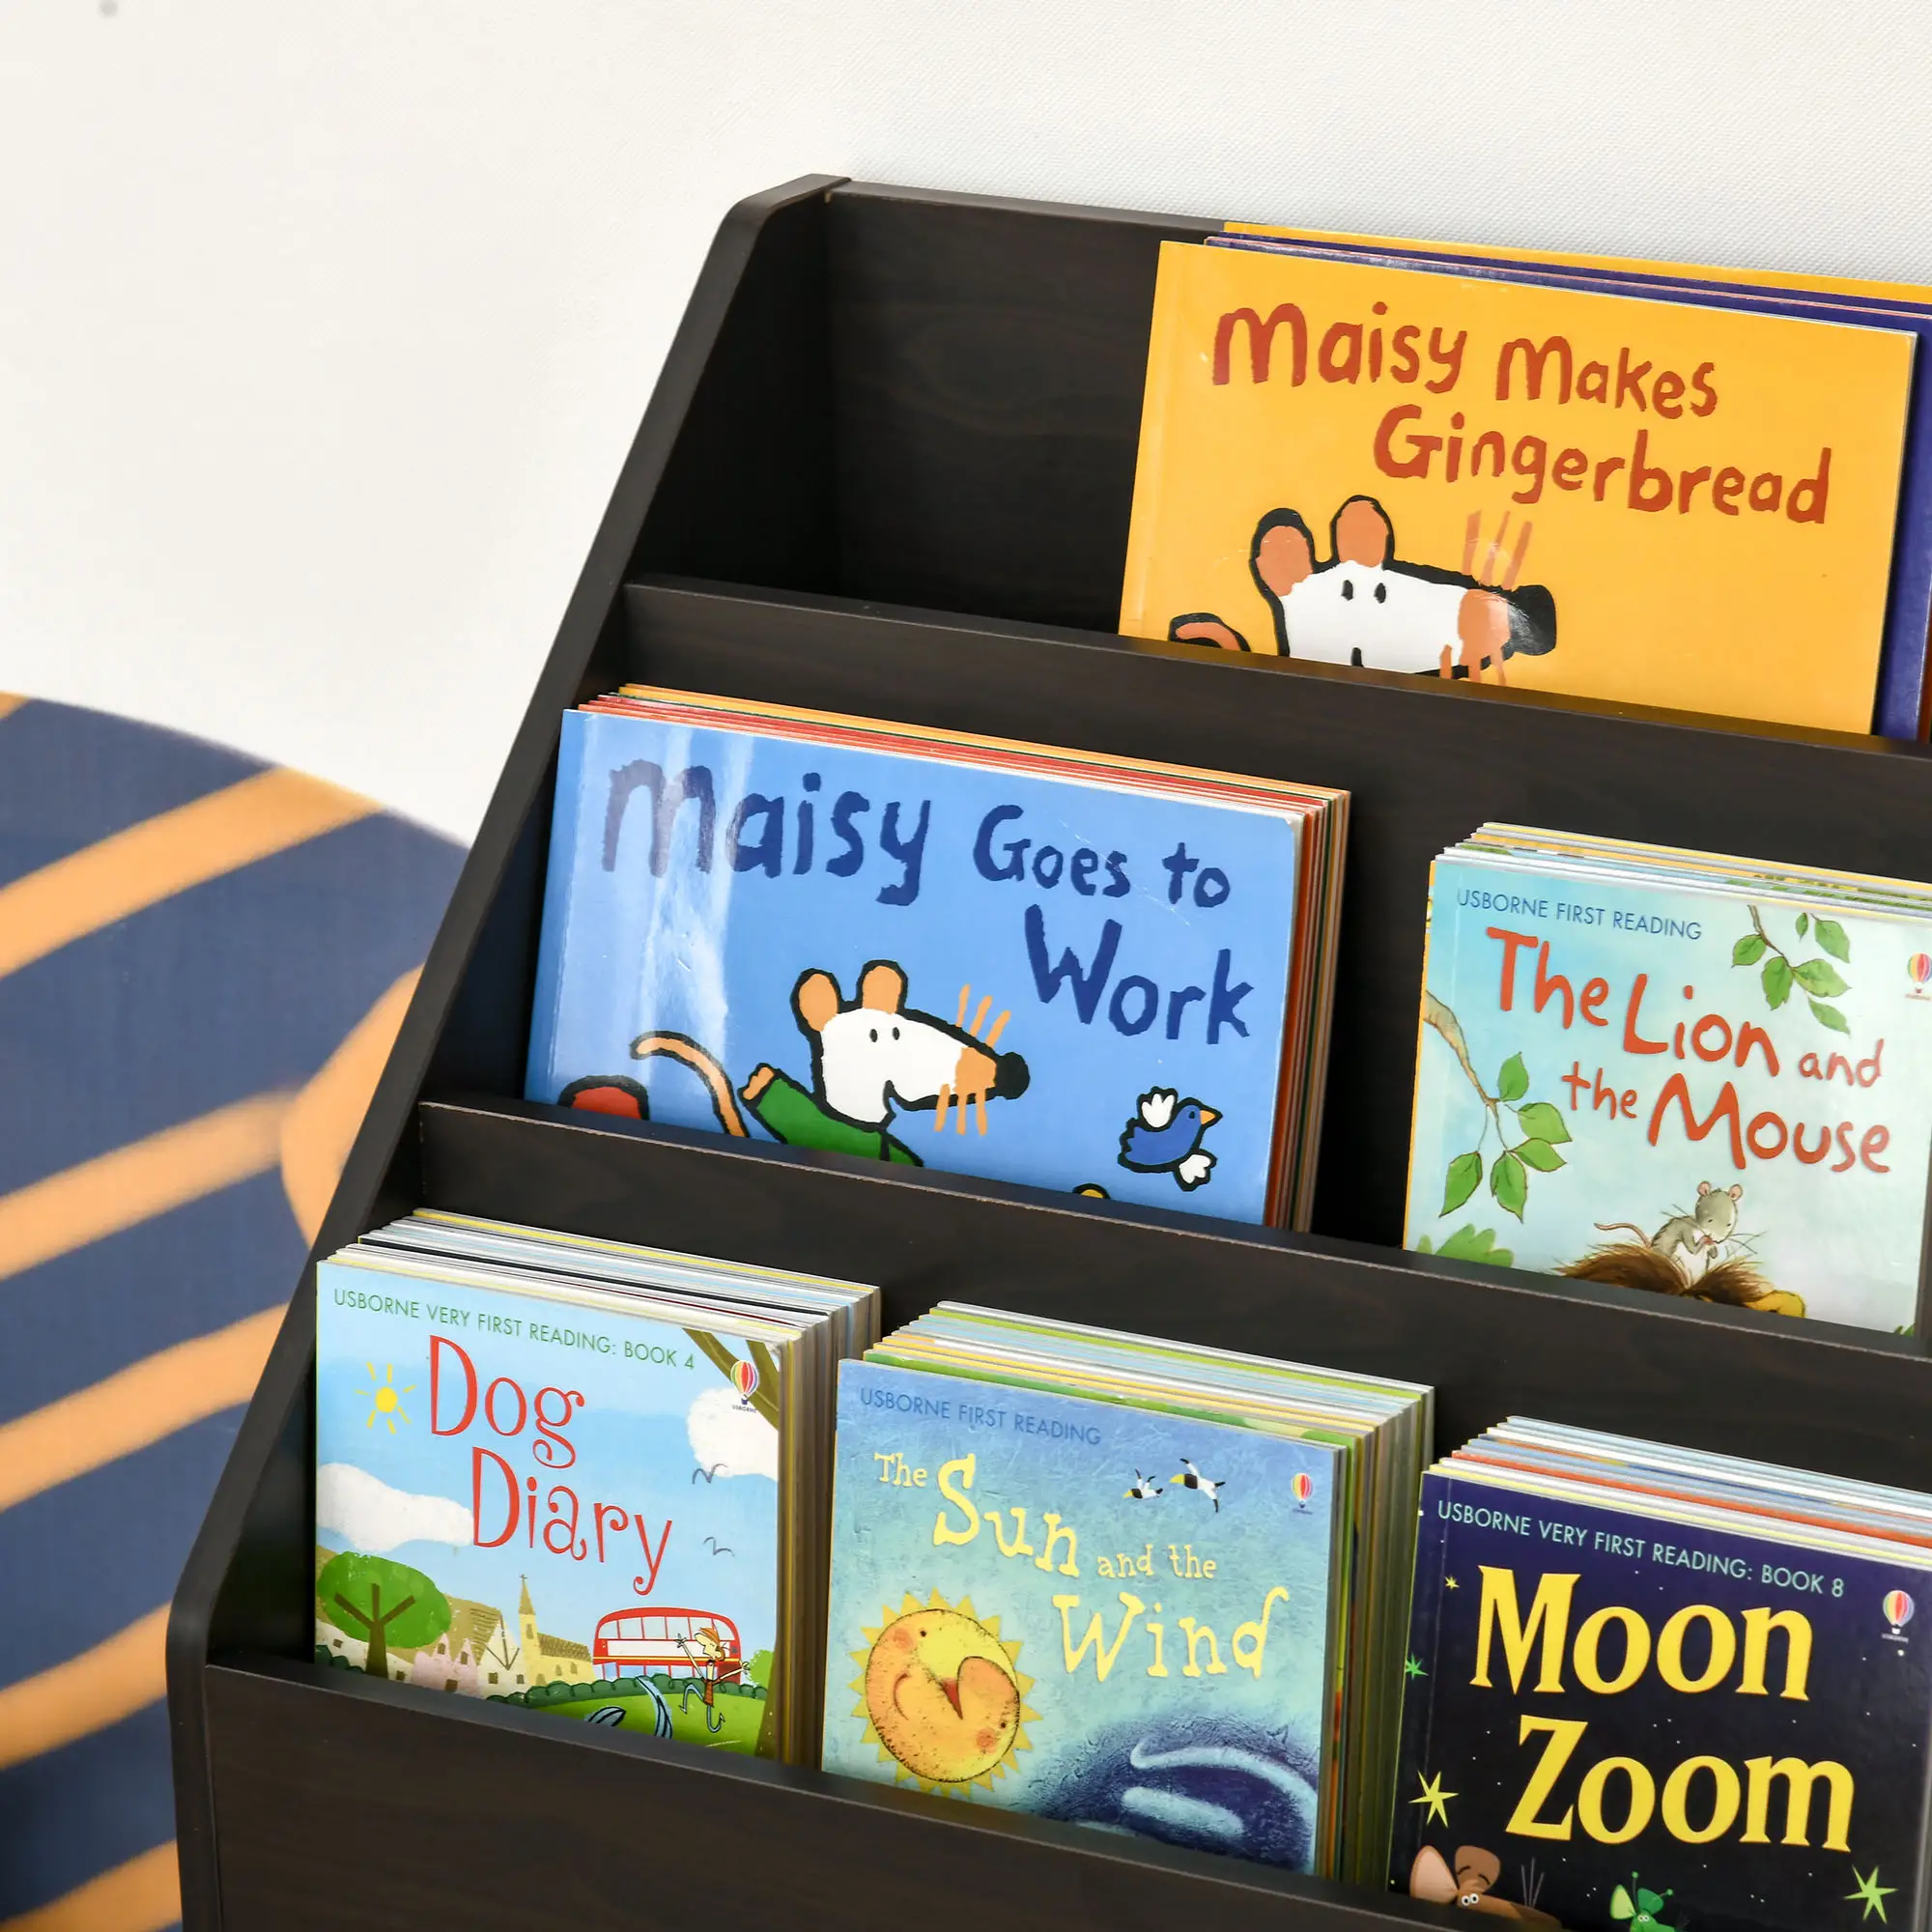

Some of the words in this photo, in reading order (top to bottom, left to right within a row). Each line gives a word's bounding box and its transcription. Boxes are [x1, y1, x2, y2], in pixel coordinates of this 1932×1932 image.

[1212, 301, 1467, 394] Maisy
[1496, 335, 1718, 419] Makes
[1374, 404, 1833, 526] Gingerbread
[601, 758, 932, 907] Maisy
[972, 804, 1131, 898] Goes
[1162, 841, 1231, 908] to
[1025, 904, 1255, 1045] Work
[1457, 888, 1548, 919] USBORNE
[1556, 902, 1606, 927] FIRST
[1612, 912, 1703, 941] READING
[1486, 926, 1609, 1030] The
[1622, 973, 1779, 1077] Lion
[1799, 1038, 1885, 1089] and
[1561, 1061, 1638, 1120] the
[1647, 1072, 1891, 1171] Mouse
[333, 1289, 420, 1320] USBORNE
[426, 1304, 471, 1328] VERY
[477, 1313, 523, 1338] FIRST
[529, 1322, 617, 1356] READING:
[624, 1341, 680, 1368] BOOK
[683, 1352, 696, 1372] 4
[429, 1333, 585, 1469] Dog
[860, 1387, 951, 1420] USBORNE
[958, 1404, 1008, 1429] FIRST
[1013, 1414, 1101, 1446] READING
[471, 1446, 673, 1596] Diary
[874, 1452, 928, 1489] The
[933, 1452, 1080, 1578] Sun
[1097, 1545, 1153, 1579] and
[1168, 1544, 1217, 1580] the
[1437, 1499, 1531, 1537] USBORNE
[1538, 1520, 1589, 1547] VERY
[1595, 1532, 1646, 1559] FIRST
[1652, 1544, 1753, 1579] READING:
[1761, 1565, 1825, 1595] BOOK
[1831, 1578, 1845, 1598] 8
[1052, 1586, 1290, 1683] Wind
[1468, 1564, 1813, 1701] Moon
[1504, 1714, 1856, 1853] Zoom
